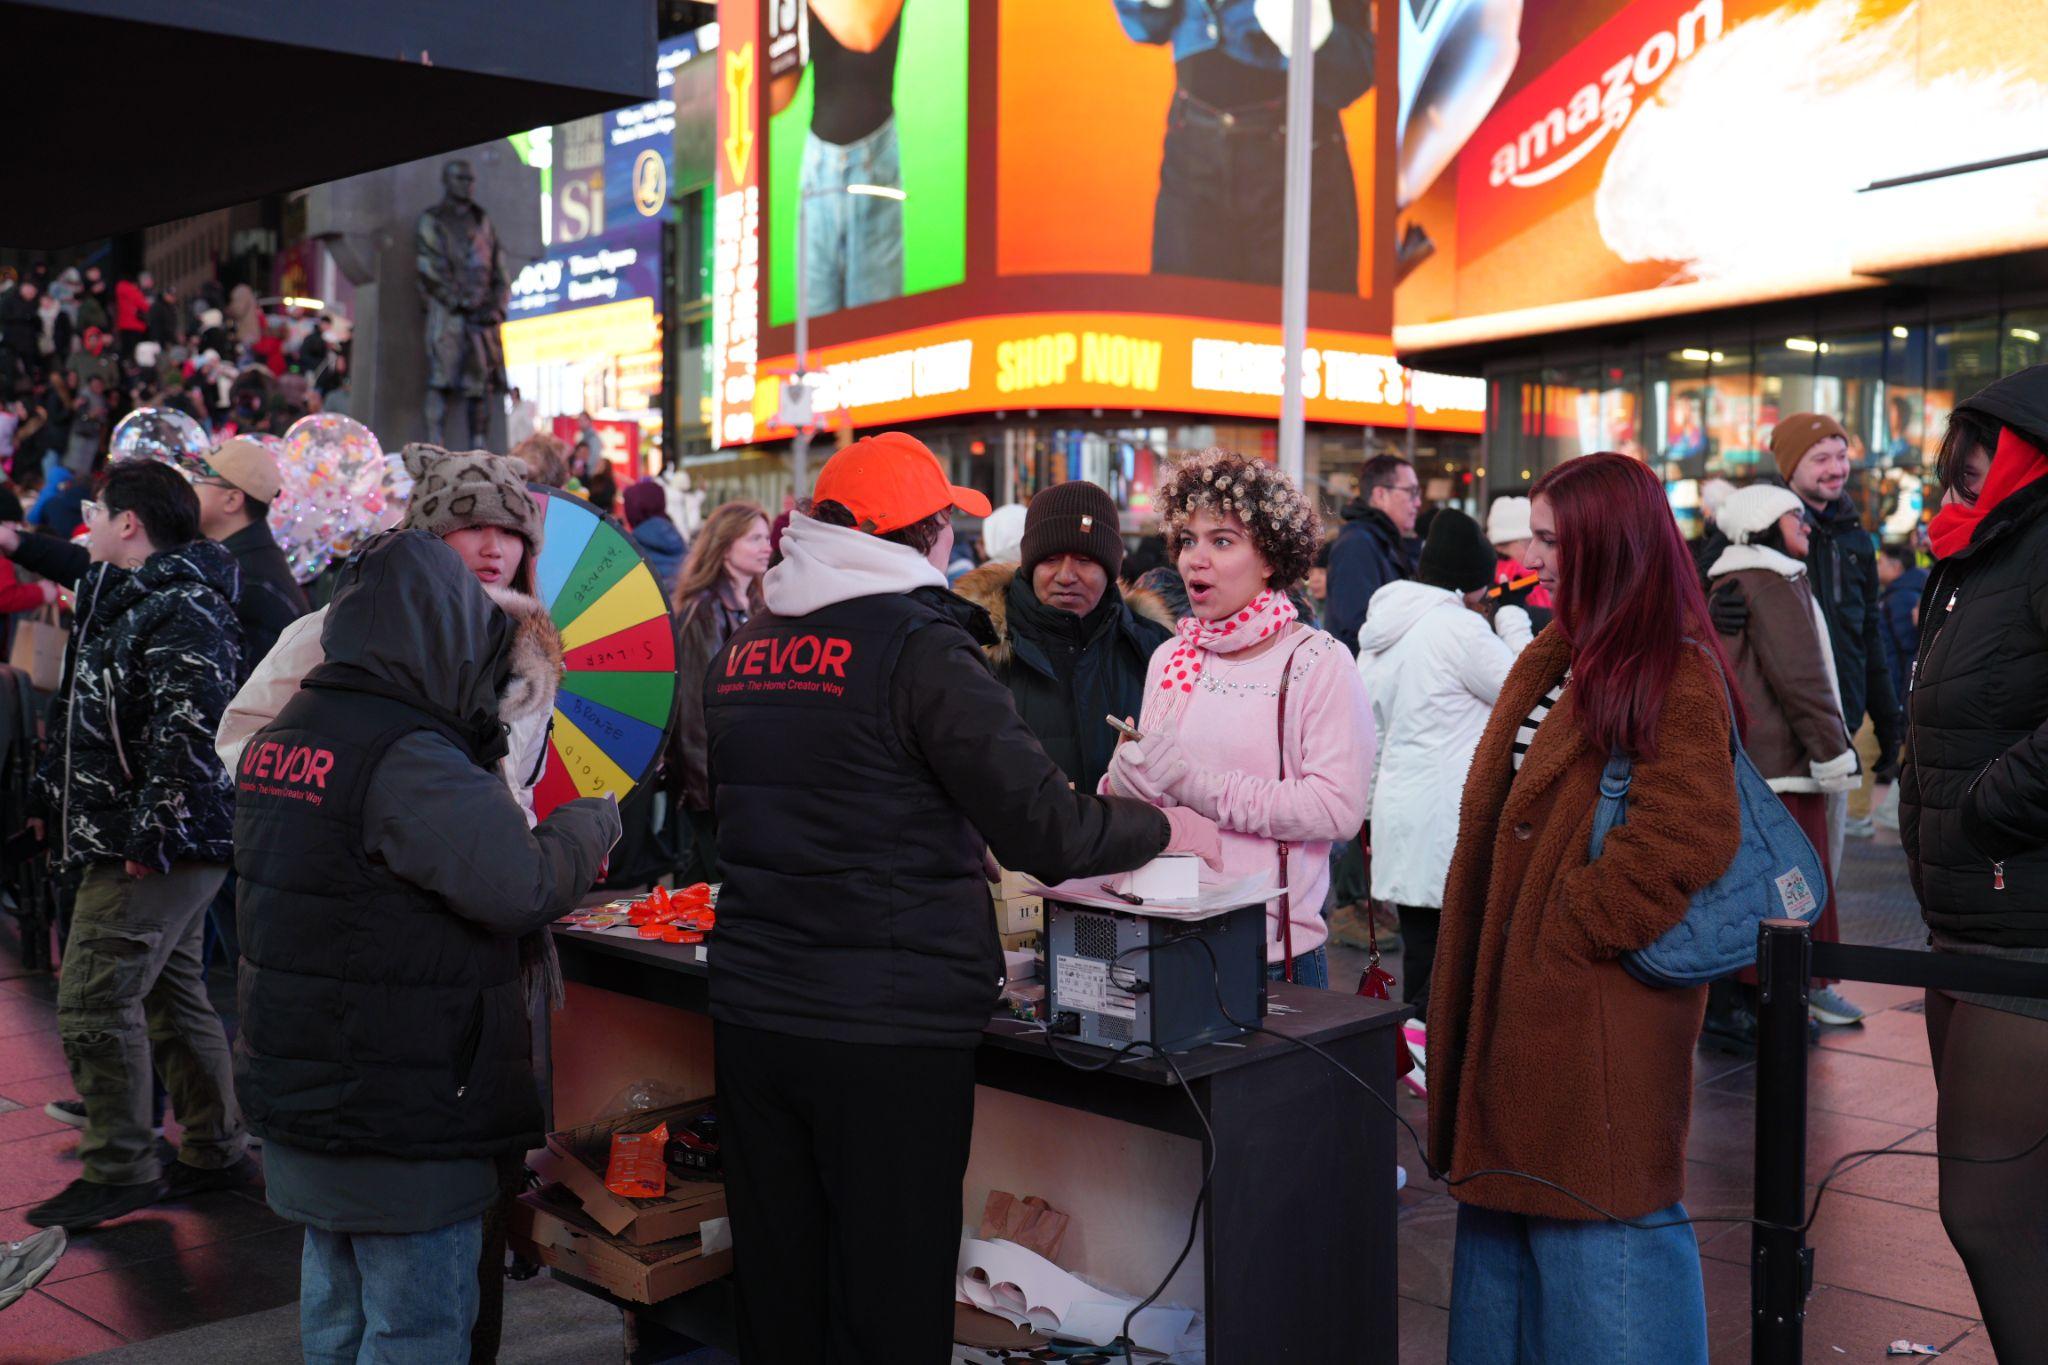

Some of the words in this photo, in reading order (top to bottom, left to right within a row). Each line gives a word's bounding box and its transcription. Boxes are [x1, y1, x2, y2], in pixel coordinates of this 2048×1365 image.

[1489, 0, 1724, 187] amazon
[997, 332, 1077, 393] SHOP
[1082, 331, 1162, 392] NOW
[725, 634, 852, 677] VEVOR
[763, 681, 784, 691] Home
[787, 679, 819, 692] Creator
[822, 681, 844, 696] Way
[242, 741, 335, 788] VEVOR
